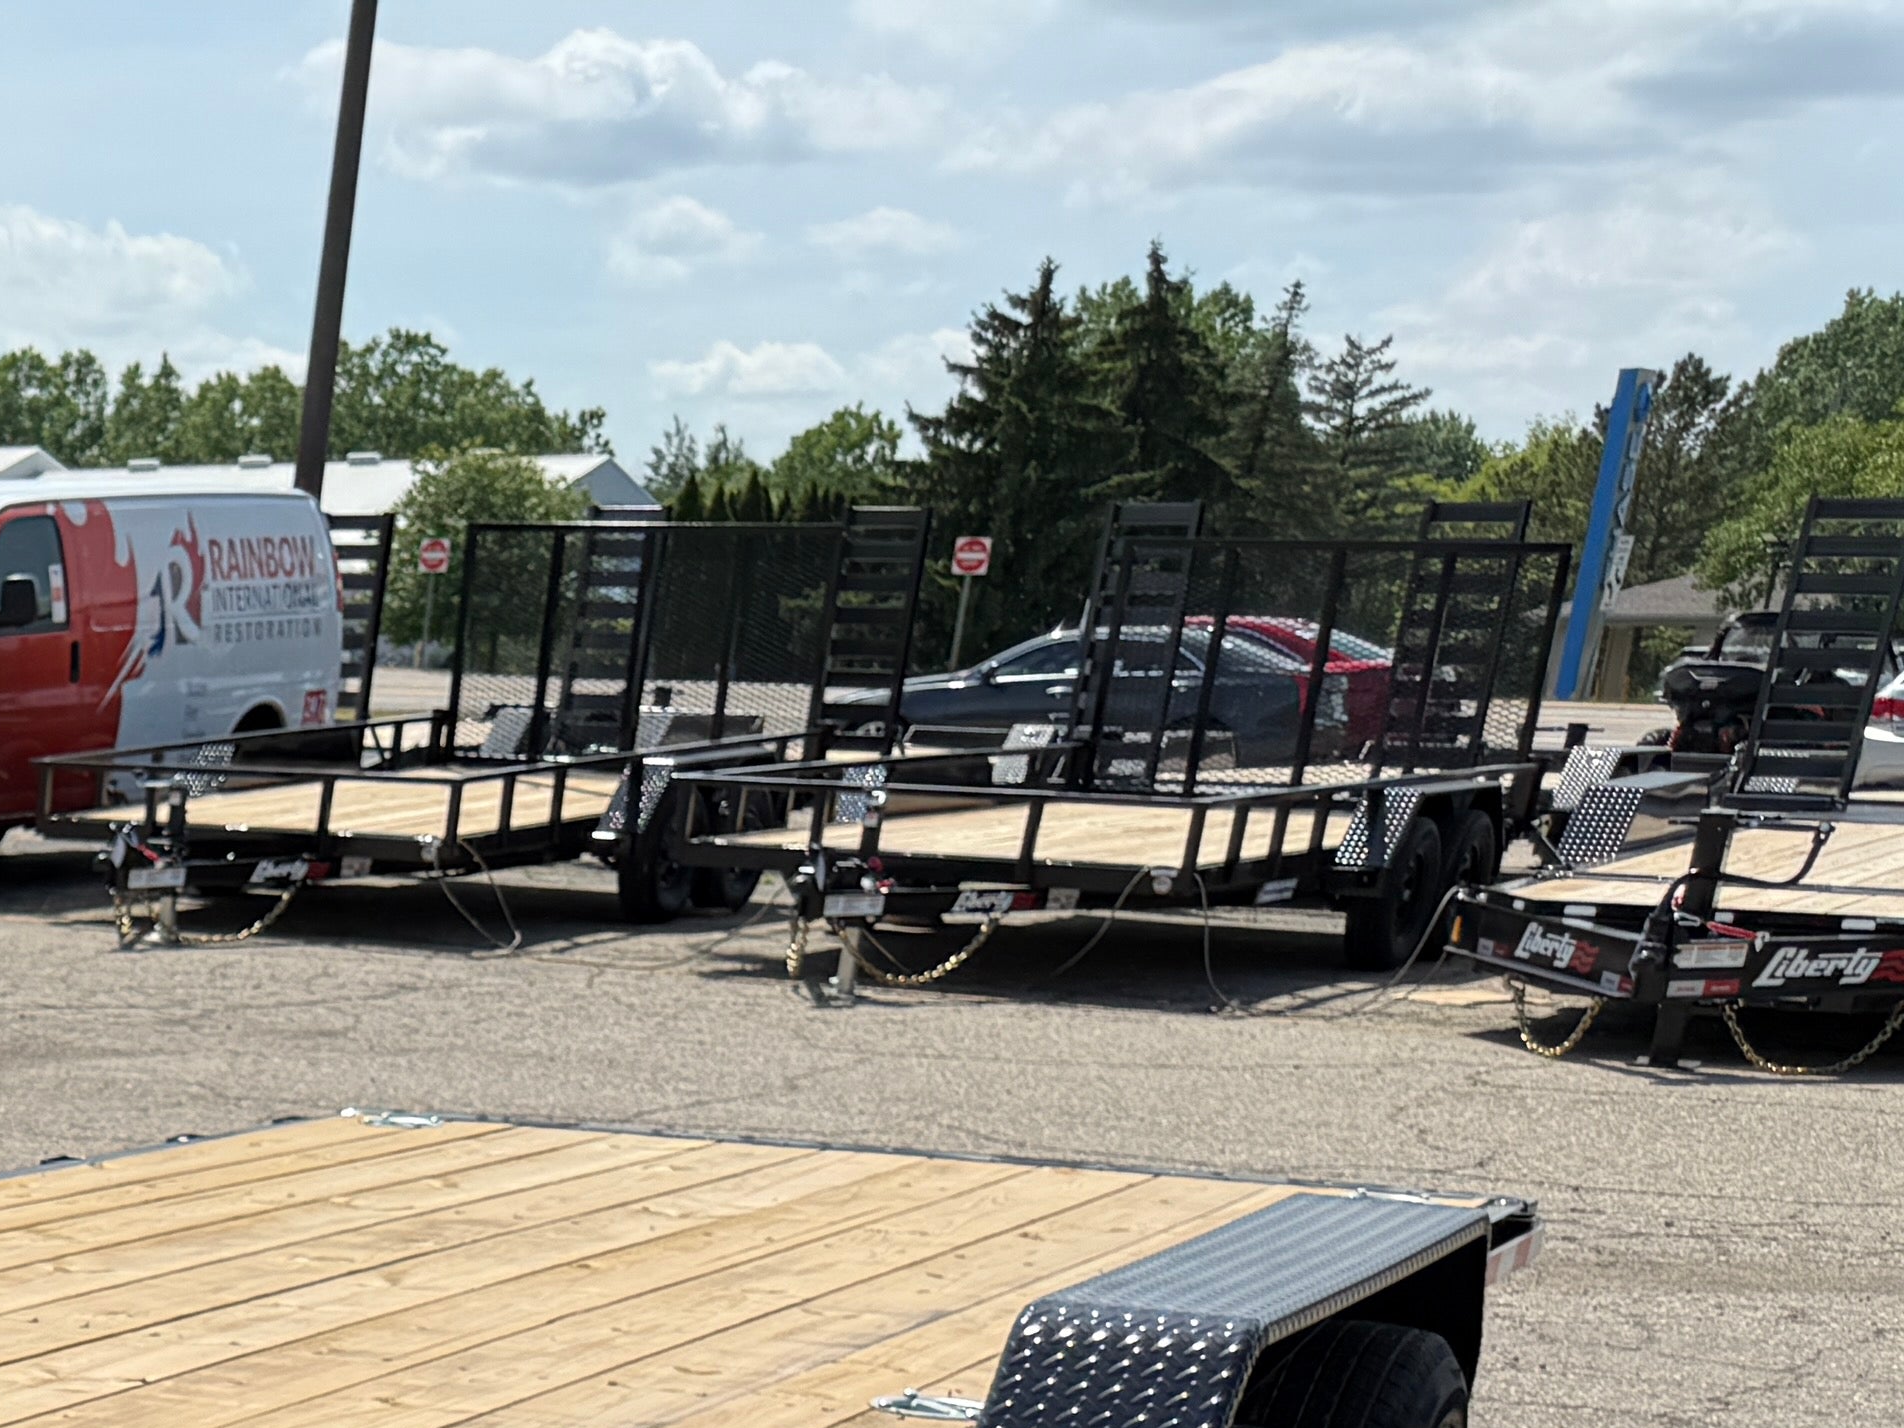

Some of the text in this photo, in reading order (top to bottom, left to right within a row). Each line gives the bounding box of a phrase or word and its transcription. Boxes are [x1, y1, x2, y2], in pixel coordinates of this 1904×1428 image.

[207, 534, 316, 582] RAINBOW
[212, 580, 320, 613] INTERNATIONAL
[213, 617, 322, 645] RESTORATION
[1513, 920, 1578, 970] Liberty
[1751, 945, 1884, 989] Liberty
